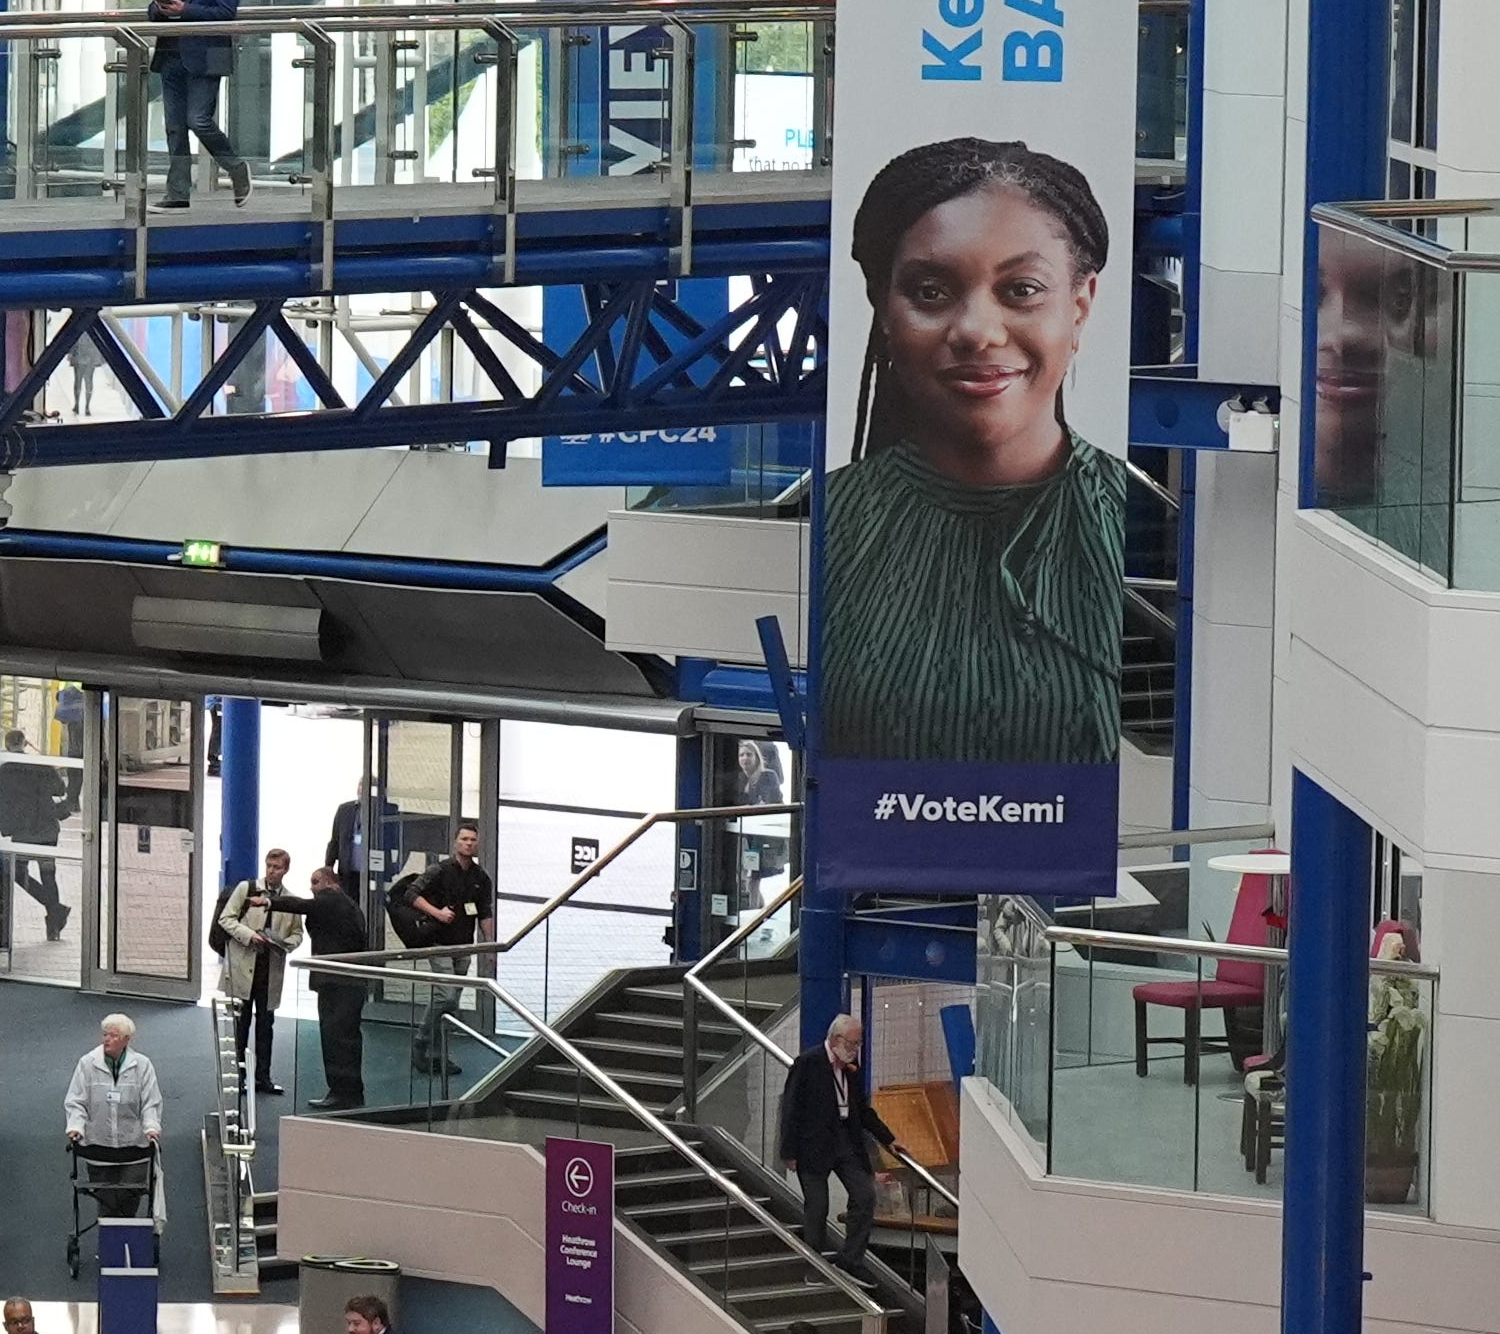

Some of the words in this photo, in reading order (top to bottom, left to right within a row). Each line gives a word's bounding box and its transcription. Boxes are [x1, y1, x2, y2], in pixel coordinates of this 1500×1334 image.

[873, 793, 1065, 826] #VoteKemi
[561, 1200, 597, 1215] Check-in
[566, 1257, 592, 1269] Lounge
